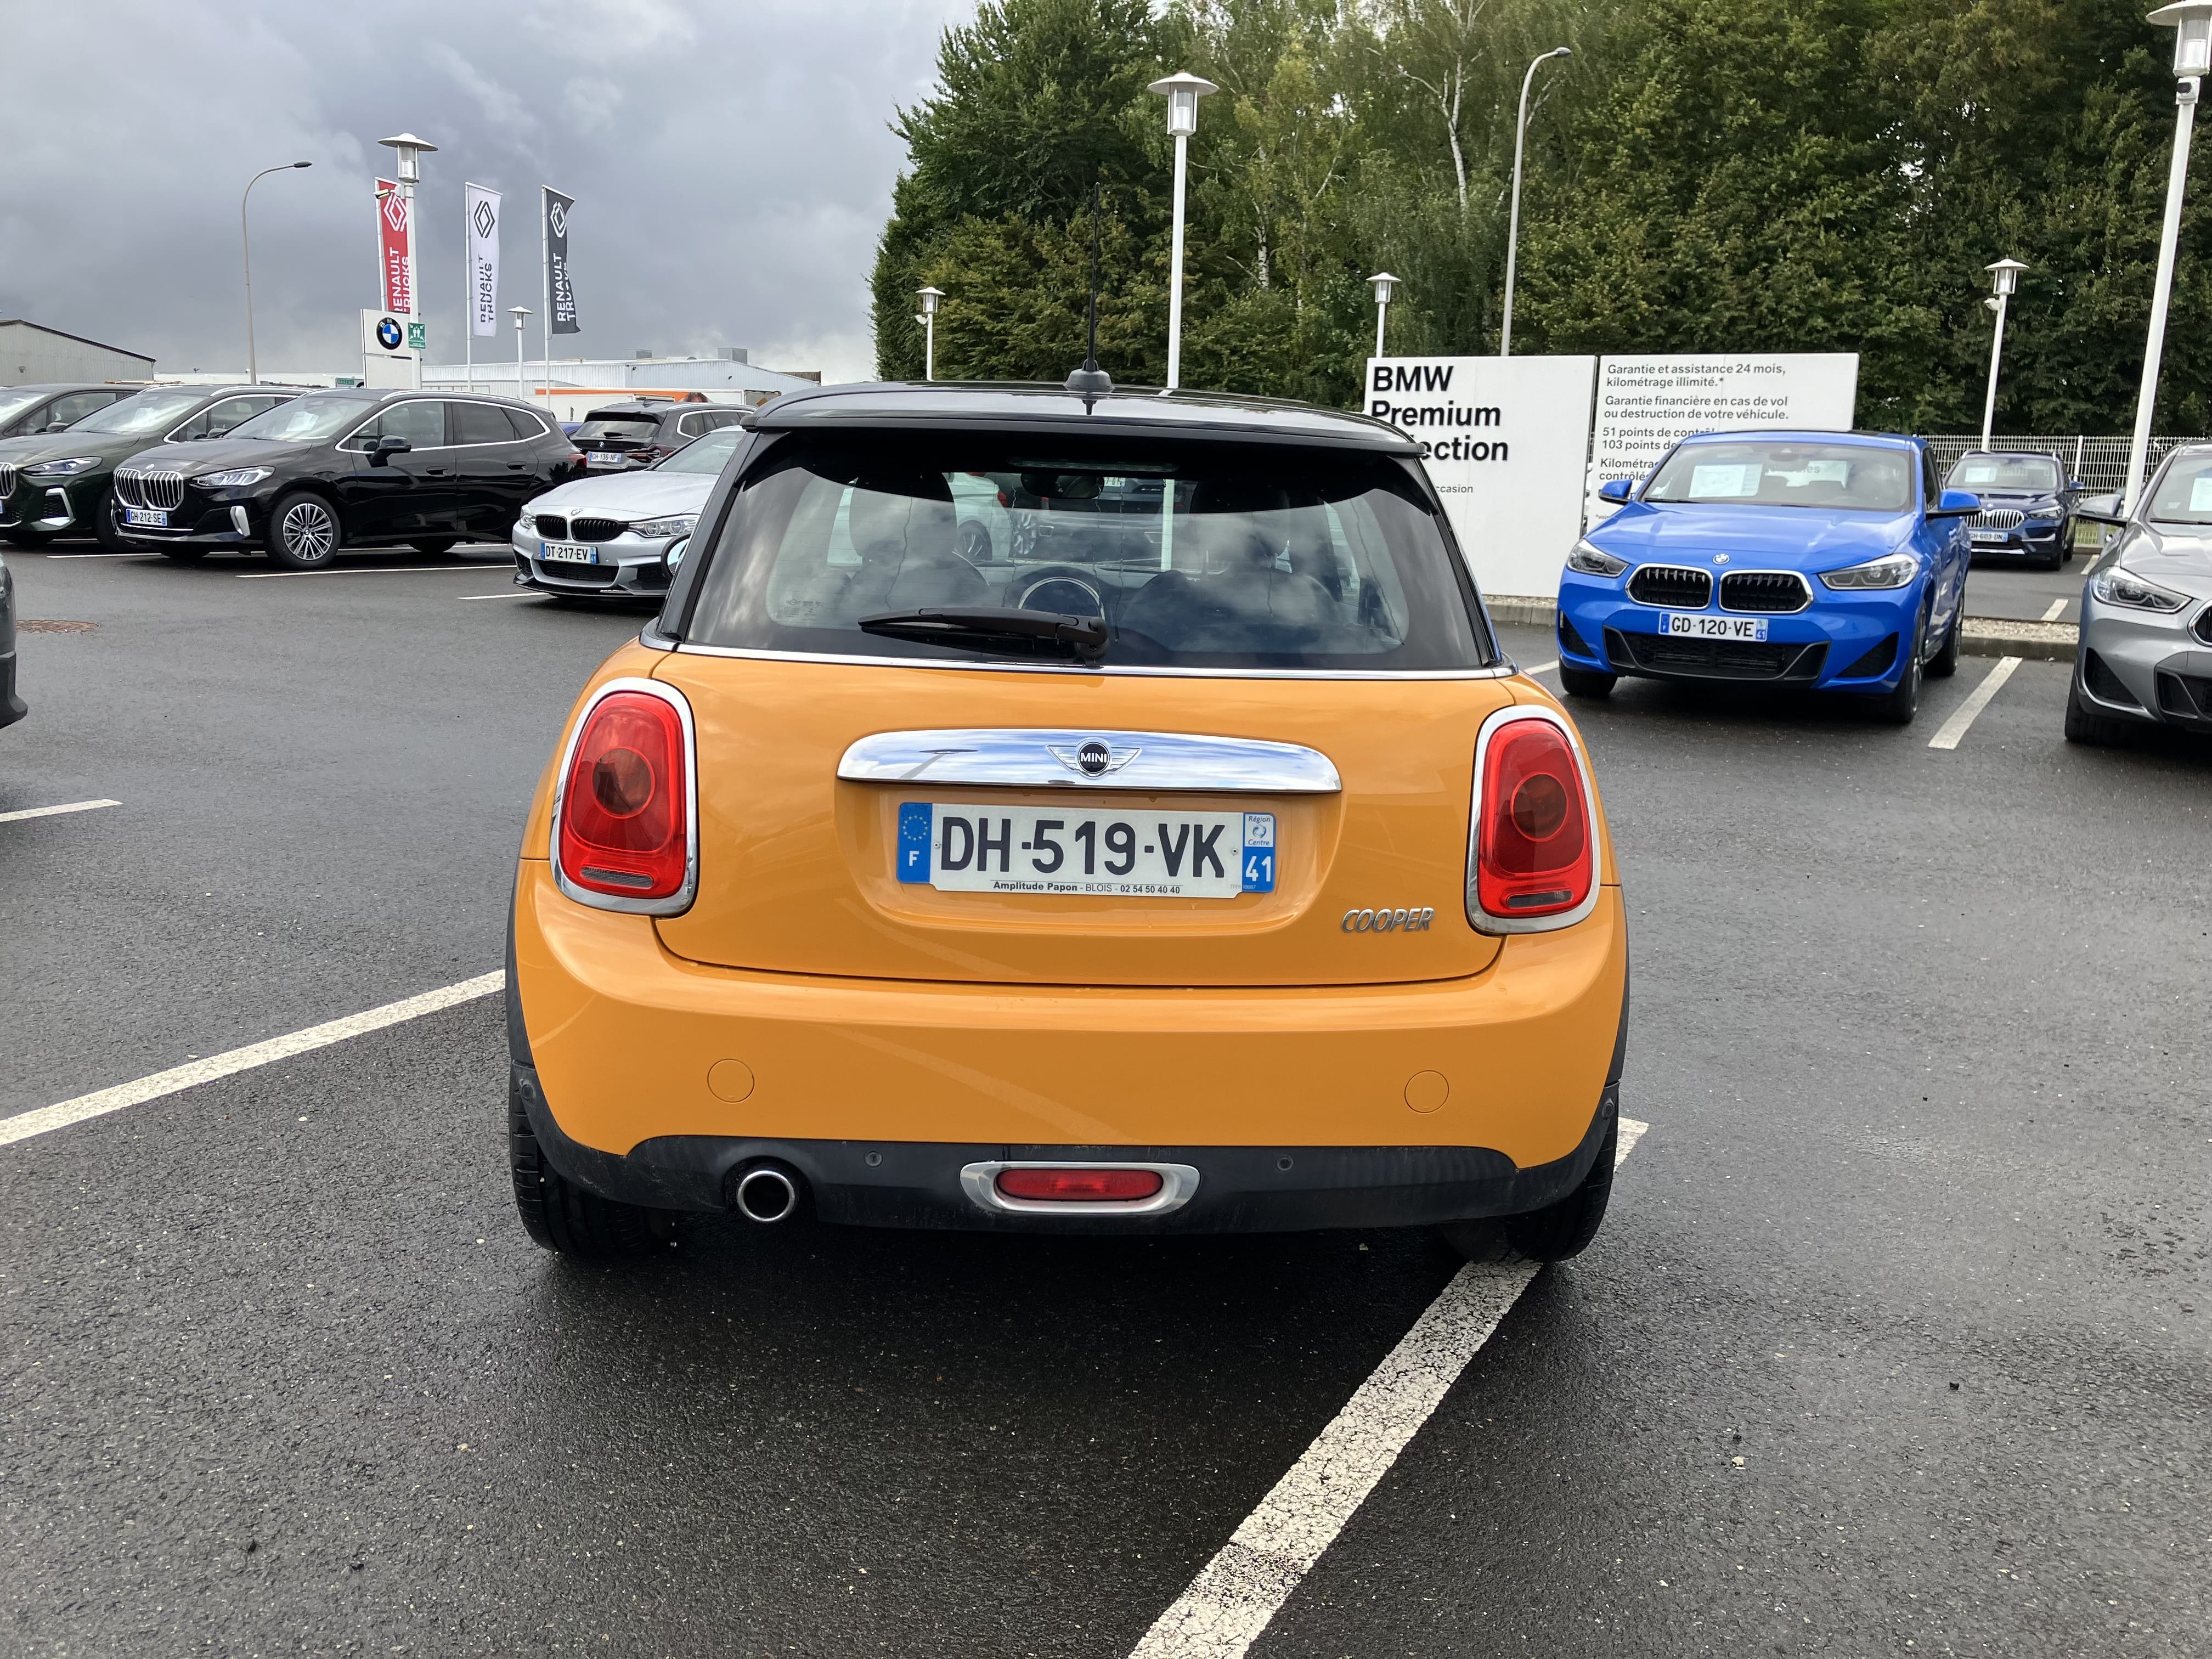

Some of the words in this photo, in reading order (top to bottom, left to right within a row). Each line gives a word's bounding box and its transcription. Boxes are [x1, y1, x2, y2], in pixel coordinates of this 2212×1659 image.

[402, 256, 410, 312] RUCKS
[553, 252, 566, 321] RENAULT
[485, 263, 494, 323] TRUCKS
[1608, 364, 1656, 374] Garantie
[1658, 365, 1669, 374] et
[1672, 364, 1734, 374] assistance
[1736, 364, 1751, 374] 24
[1754, 364, 1786, 375] mois,
[1373, 365, 1454, 392] BMW
[1606, 377, 1673, 388] kilométrage
[1605, 396, 1653, 406] Garantie
[1655, 395, 1712, 406] financière
[1714, 398, 1728, 406] en
[1730, 398, 1751, 406] cas
[1753, 396, 1768, 406] de
[1770, 396, 1788, 406] vol
[1372, 400, 1501, 426] Premium
[1620, 409, 1685, 418] destruction
[1688, 409, 1702, 418] de
[1704, 410, 1734, 419] votre
[1736, 409, 1789, 419] véhicule.
[1602, 427, 1616, 436] 51
[1619, 427, 1655, 438] points
[1657, 428, 1671, 437] de
[1419, 434, 1509, 461] ection
[1602, 439, 1623, 449] 103
[1625, 440, 1661, 451] points
[1600, 458, 1659, 468] Kilométra
[131, 511, 162, 523] GH-212-SE
[546, 545, 588, 560] DT-217-EV
[1672, 617, 1754, 637] GD-120-VE
[1757, 631, 1765, 640] 41
[1080, 752, 1107, 763] MINI
[909, 851, 919, 867] F
[940, 816, 1225, 878] DH-519-VK
[1245, 855, 1271, 882] 41
[993, 881, 1043, 891] Amplitude
[1047, 882, 1077, 893] Papon
[1085, 884, 1113, 892] BLOIS
[1133, 885, 1143, 893] 54
[1158, 885, 1167, 894] 40
[1170, 885, 1180, 894] 40
[1341, 907, 1435, 933] COOPER
